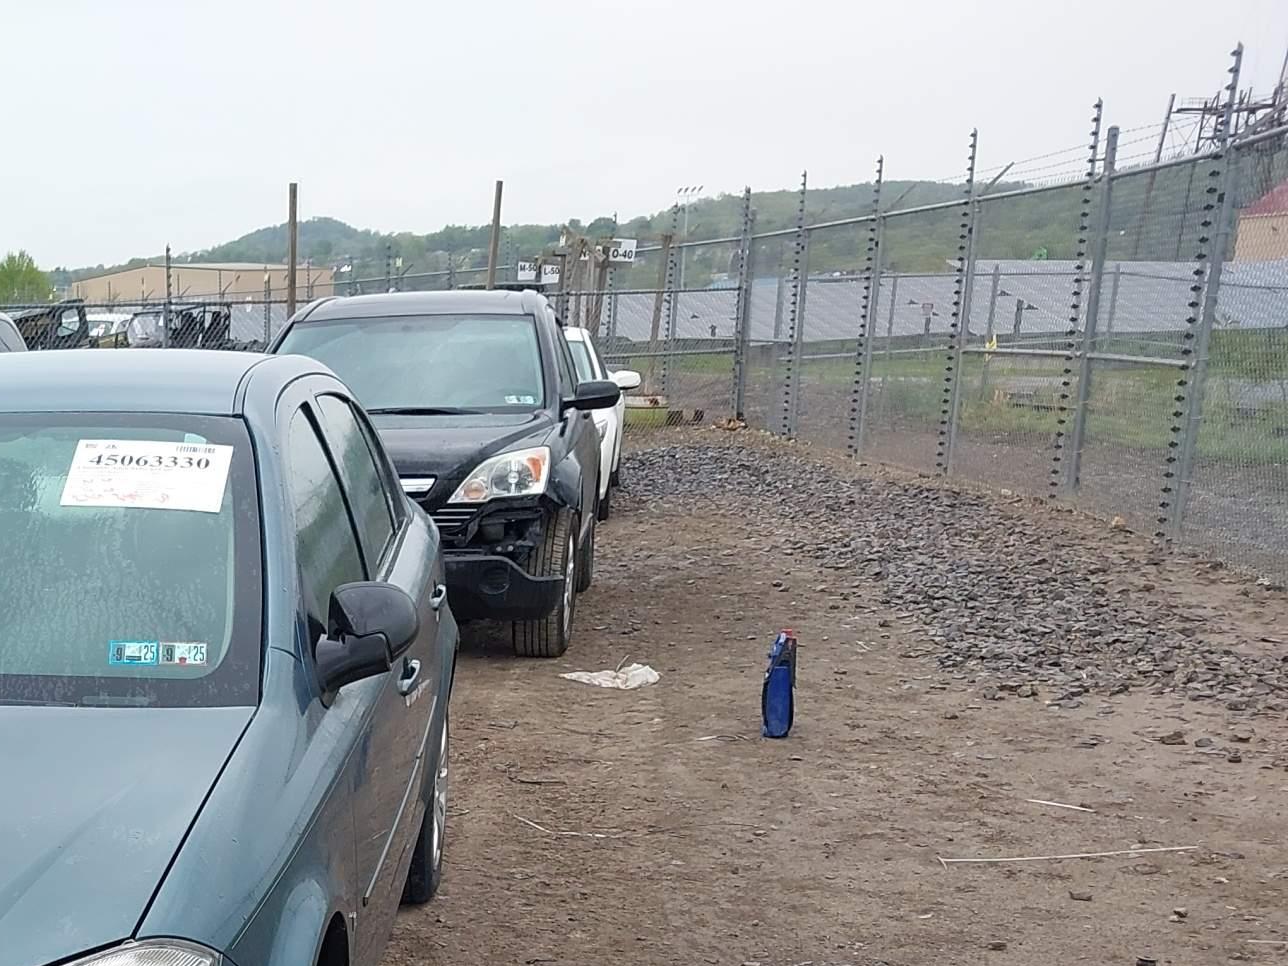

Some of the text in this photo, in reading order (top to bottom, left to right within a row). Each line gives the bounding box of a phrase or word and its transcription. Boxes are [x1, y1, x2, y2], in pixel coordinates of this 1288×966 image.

[88, 453, 211, 470] 45063330
[143, 644, 155, 661] 25
[193, 645, 205, 662] 25
